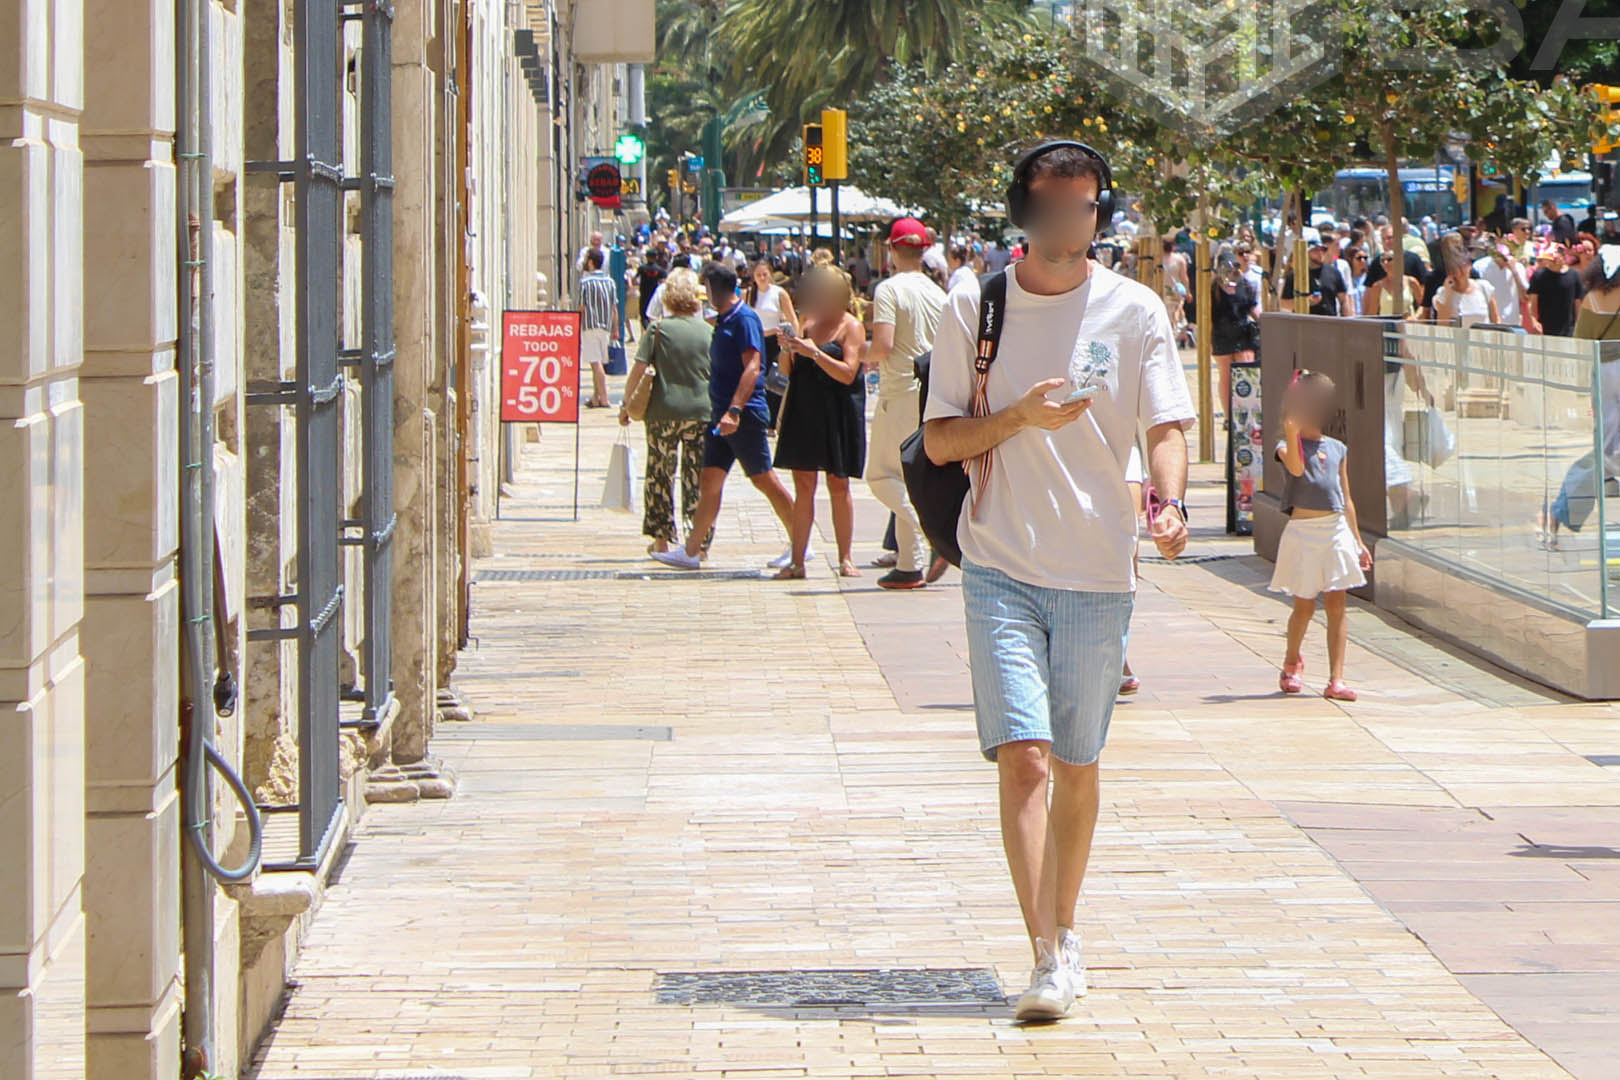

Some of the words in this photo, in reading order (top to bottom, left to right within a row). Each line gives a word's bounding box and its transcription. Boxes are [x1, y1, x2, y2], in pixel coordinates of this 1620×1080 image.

[807, 147, 822, 165] 38
[509, 324, 573, 338] REBAJAS
[523, 341, 559, 353] TODO
[508, 356, 573, 385] -70%
[506, 386, 573, 414] -50%
